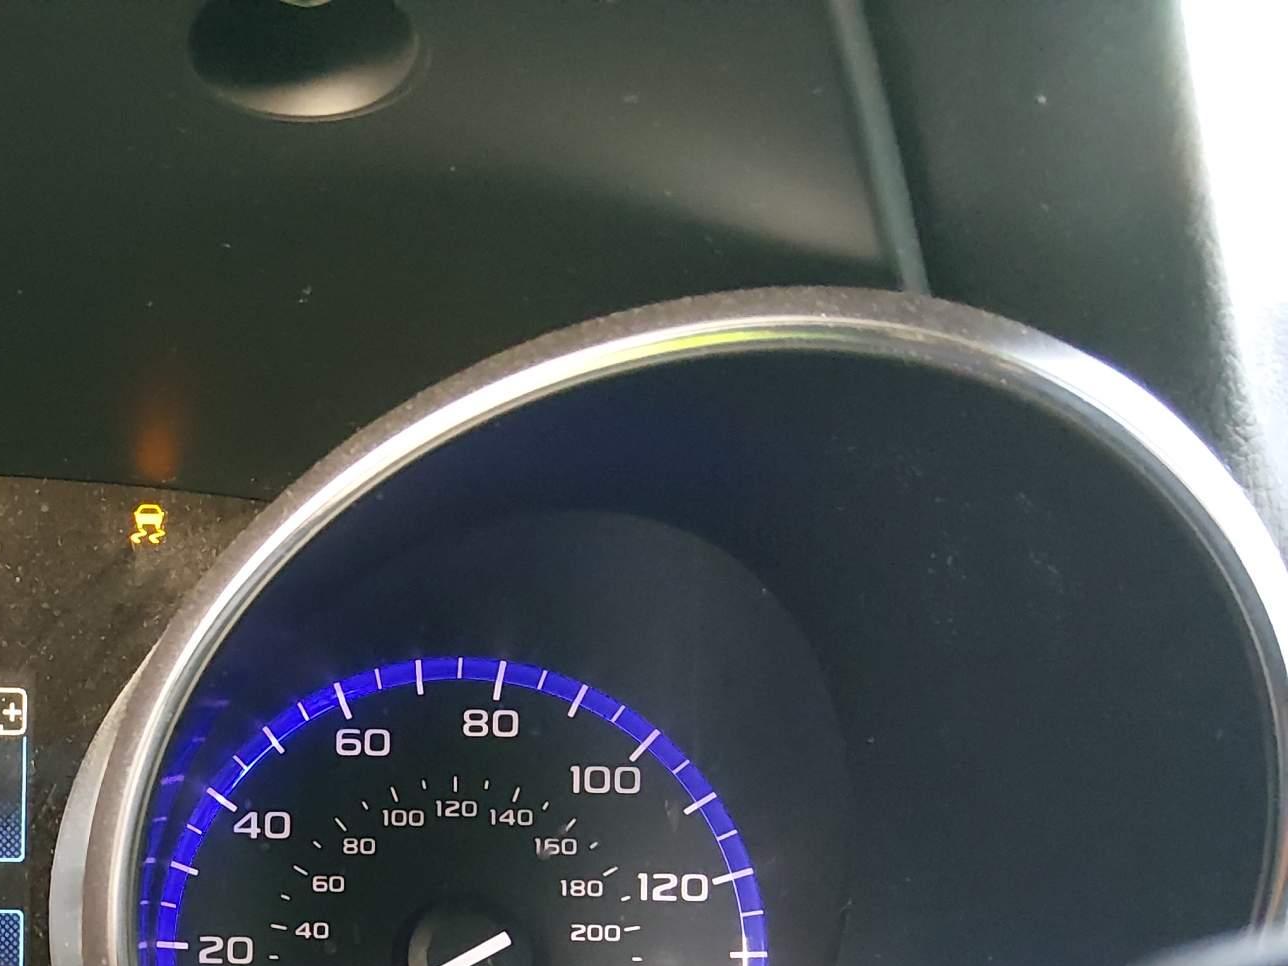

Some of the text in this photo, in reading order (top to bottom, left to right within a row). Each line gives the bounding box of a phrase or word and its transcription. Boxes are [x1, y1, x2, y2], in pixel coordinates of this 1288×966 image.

[462, 709, 519, 738] 80
[335, 728, 391, 757] 60
[569, 765, 641, 795] 100
[435, 800, 478, 818] 120
[489, 808, 534, 827] 140
[233, 812, 291, 840] 40
[382, 810, 425, 828] 100
[342, 838, 376, 856] 80
[534, 837, 578, 856] 160
[312, 875, 345, 894] 60
[560, 879, 604, 898] 180
[637, 872, 709, 902] 120
[294, 922, 330, 941] 40
[570, 923, 621, 942] 200
[199, 936, 254, 966] 20
